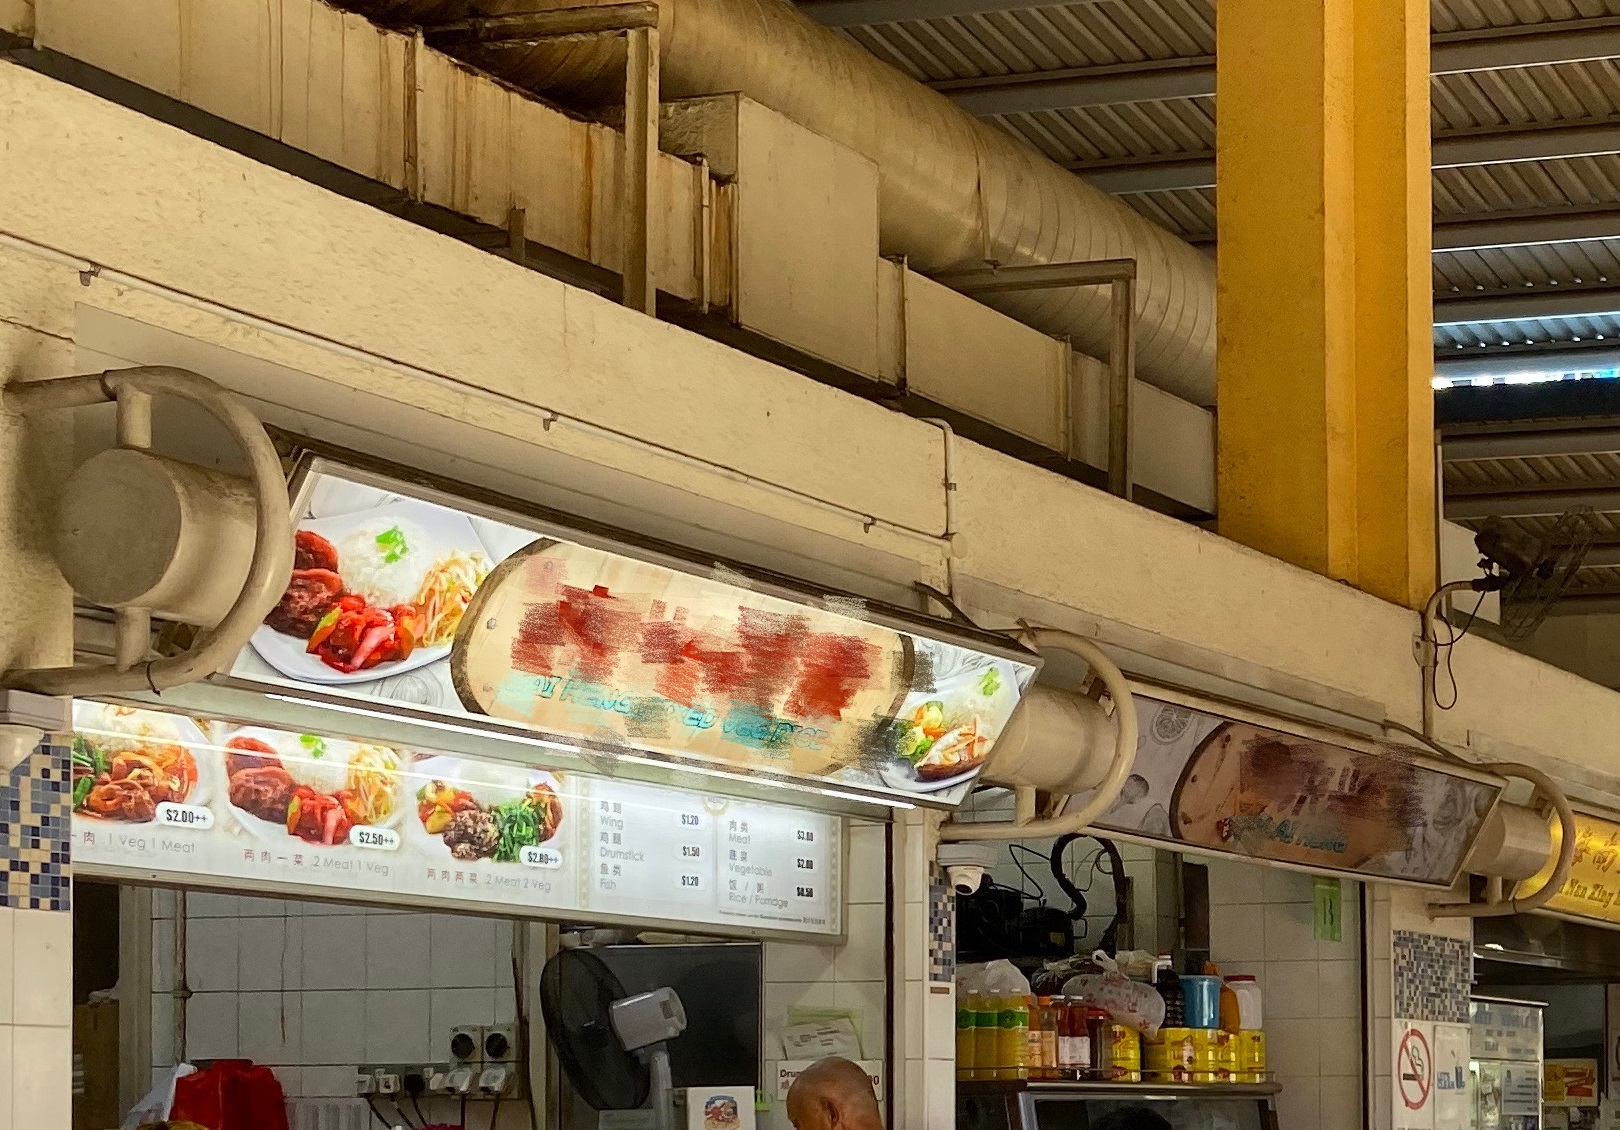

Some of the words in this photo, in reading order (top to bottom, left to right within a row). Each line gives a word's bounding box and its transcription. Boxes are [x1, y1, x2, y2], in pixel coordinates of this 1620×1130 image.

[165, 808, 208, 825] $2.00++
[600, 815, 624, 830] Wing
[681, 813, 699, 825] $1.20
[118, 833, 146, 851] Veg
[161, 839, 196, 854] Meat
[358, 831, 395, 847] $2.50++
[728, 833, 751, 845] Meat
[600, 846, 645, 862] Drumstick
[682, 845, 700, 857] $1.50
[313, 854, 320, 868] 2
[322, 856, 354, 871] Meat
[365, 860, 390, 877] Veg
[728, 863, 773, 877] Vegetable
[486, 874, 492, 885] 2
[494, 875, 521, 888] Meat
[523, 877, 529, 888] 2
[531, 879, 551, 893] Veg
[600, 878, 617, 891] Fish
[728, 892, 747, 903] Rice
